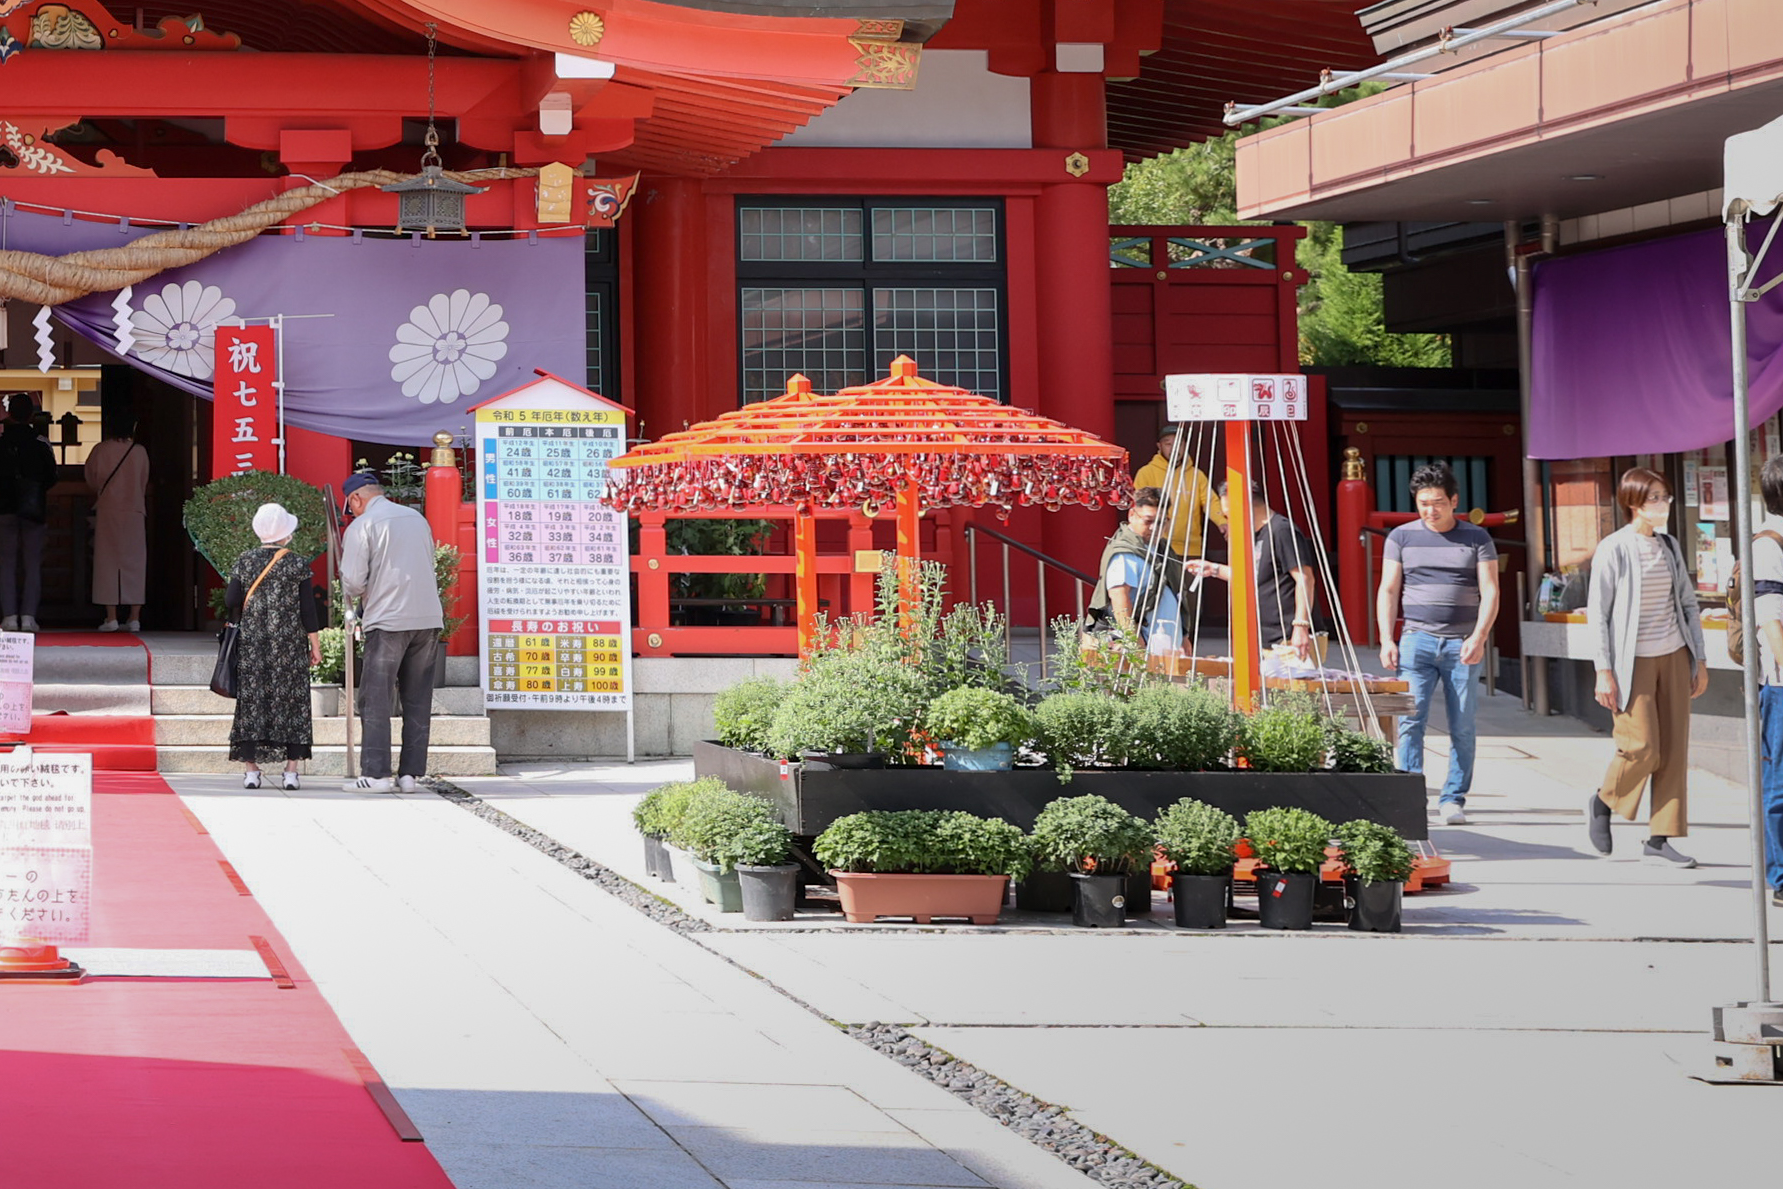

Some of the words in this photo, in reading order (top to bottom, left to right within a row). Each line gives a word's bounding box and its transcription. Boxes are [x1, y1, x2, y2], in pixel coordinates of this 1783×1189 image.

[1258, 404, 1270, 417] 辰
[505, 427, 532, 437] 前厄
[545, 428, 572, 437] 本厄
[585, 428, 612, 438] 後厄
[506, 448, 532, 458] 24歳
[546, 448, 571, 458] 25歳
[586, 448, 613, 459] 26歳
[485, 453, 496, 484] 男性
[507, 468, 532, 478] 41歳
[547, 469, 572, 479] 42歳
[507, 489, 533, 499] 60歳
[547, 489, 572, 499] 61歳
[508, 511, 533, 521] 18歳
[548, 512, 573, 522] 19歳
[588, 512, 613, 522] 20歳
[486, 518, 497, 548] 女性
[508, 532, 533, 542] 32歳
[548, 532, 573, 542] 33歳
[588, 533, 613, 543] 34歳
[509, 552, 534, 562] 36歳
[549, 553, 574, 563] 37歳
[589, 553, 614, 563] 38歳
[511, 621, 600, 632] 長寿のお祝い
[525, 638, 550, 647] 61歳
[560, 639, 582, 648] 米寿
[593, 639, 617, 648] 88歳
[493, 652, 515, 662] 古希
[526, 652, 550, 661] 70歳
[560, 653, 582, 662] 卒寿
[593, 653, 618, 662] 90歳
[526, 666, 551, 675] 77歳
[560, 667, 583, 677] 白寿
[593, 667, 618, 676] 99歳
[526, 681, 551, 689] 80歳
[560, 681, 583, 691] 上寿
[592, 682, 619, 690] 100歳
[45, 794, 62, 802] ahead
[22, 804, 42, 812] Please
